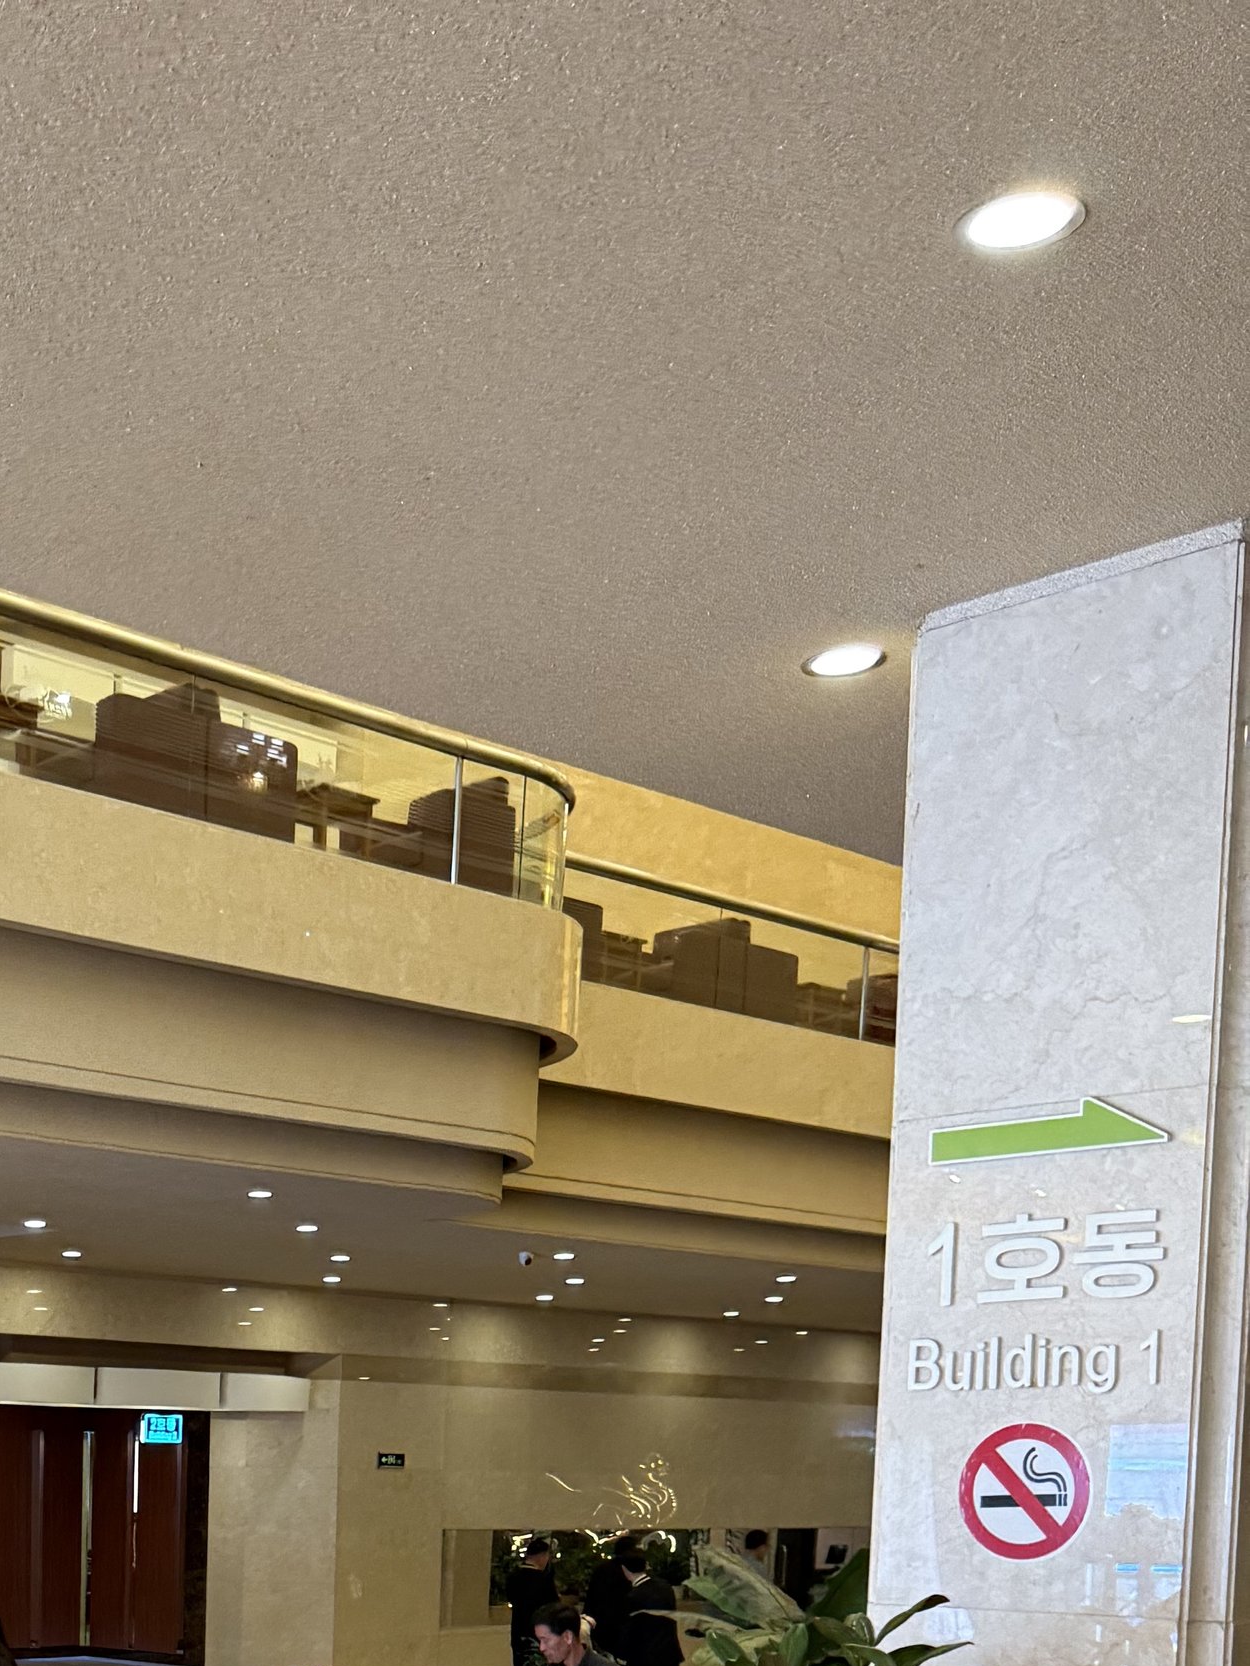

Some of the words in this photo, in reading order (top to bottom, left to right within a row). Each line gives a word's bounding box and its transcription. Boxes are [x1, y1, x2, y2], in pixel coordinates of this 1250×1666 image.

[927, 1208, 1165, 1307] 1호동
[907, 1333, 1118, 1394] Building
[1141, 1328, 1162, 1386] 1
